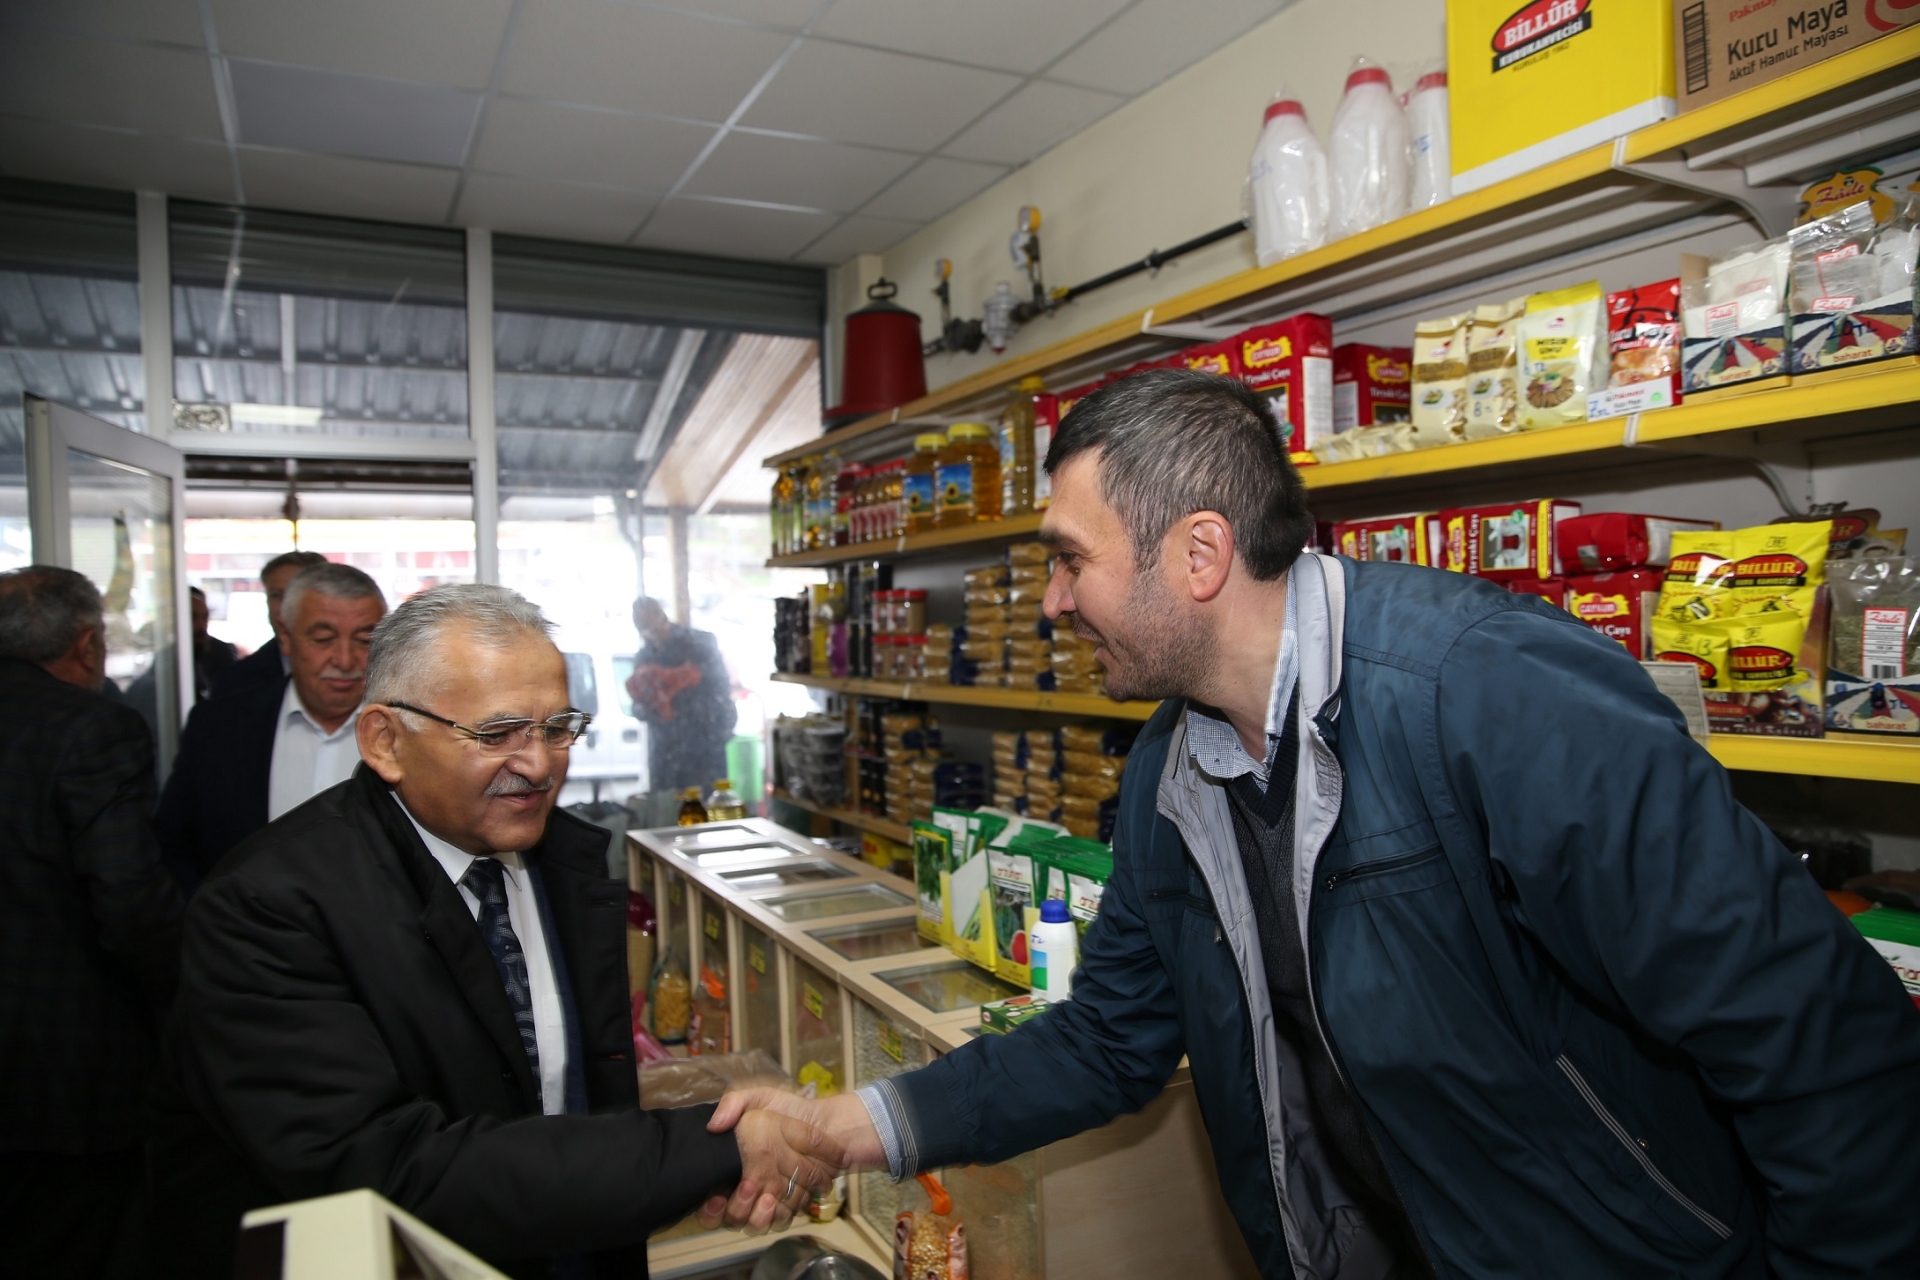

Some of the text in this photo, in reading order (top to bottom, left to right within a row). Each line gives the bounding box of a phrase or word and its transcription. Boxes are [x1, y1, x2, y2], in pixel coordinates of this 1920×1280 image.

[1727, 0, 1849, 65] Kuru Maya
[1728, 25, 1849, 82] Aktif Hamur Mayası
[1832, 349, 1873, 363] baharat
[1866, 721, 1907, 731] baharat
